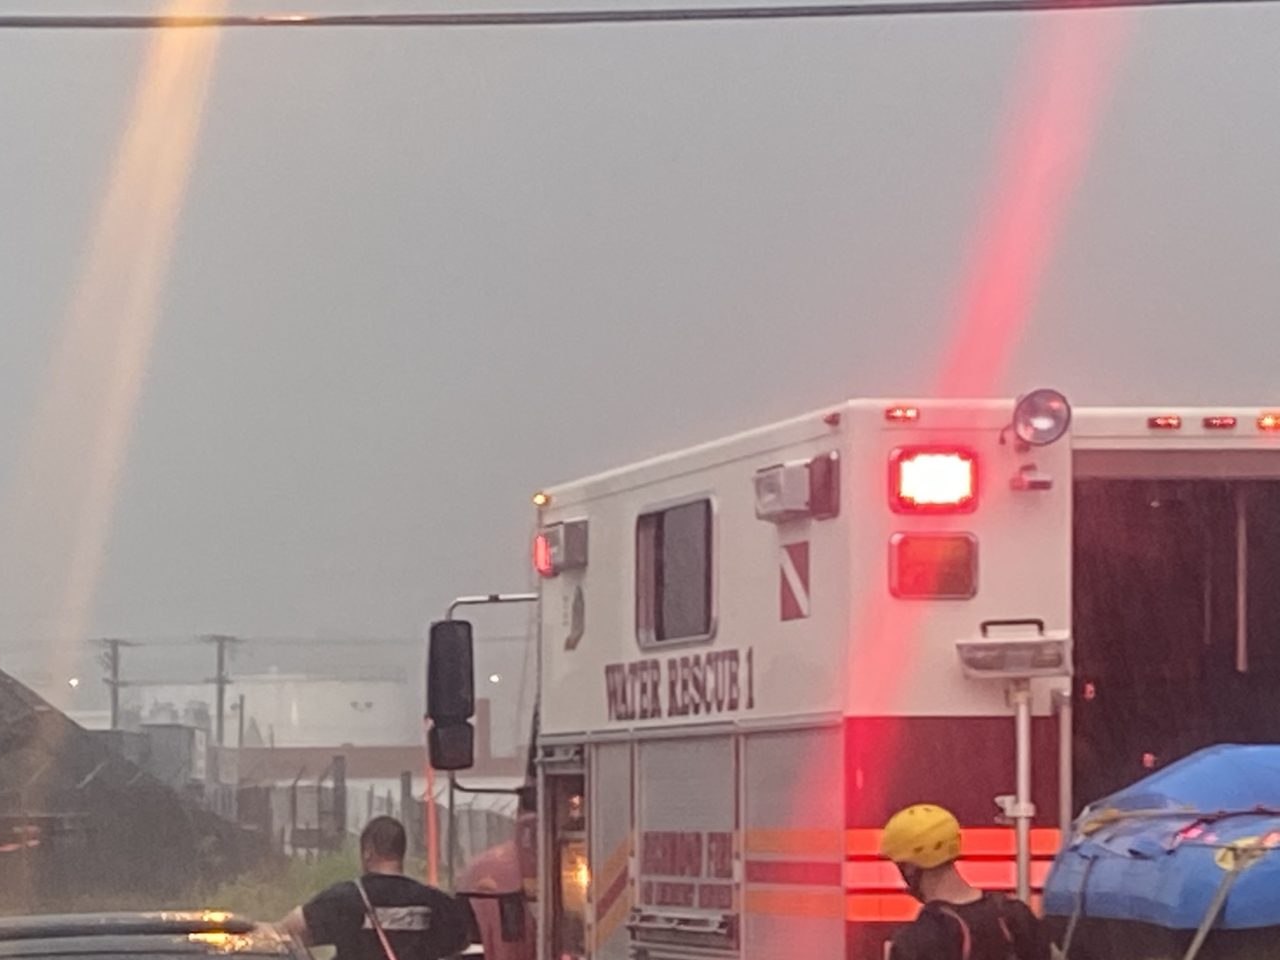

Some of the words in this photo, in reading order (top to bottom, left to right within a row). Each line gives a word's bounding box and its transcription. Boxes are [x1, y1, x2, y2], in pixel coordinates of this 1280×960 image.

[604, 659, 662, 722] WATER
[667, 649, 740, 718] RESCUE
[746, 645, 755, 710] 1
